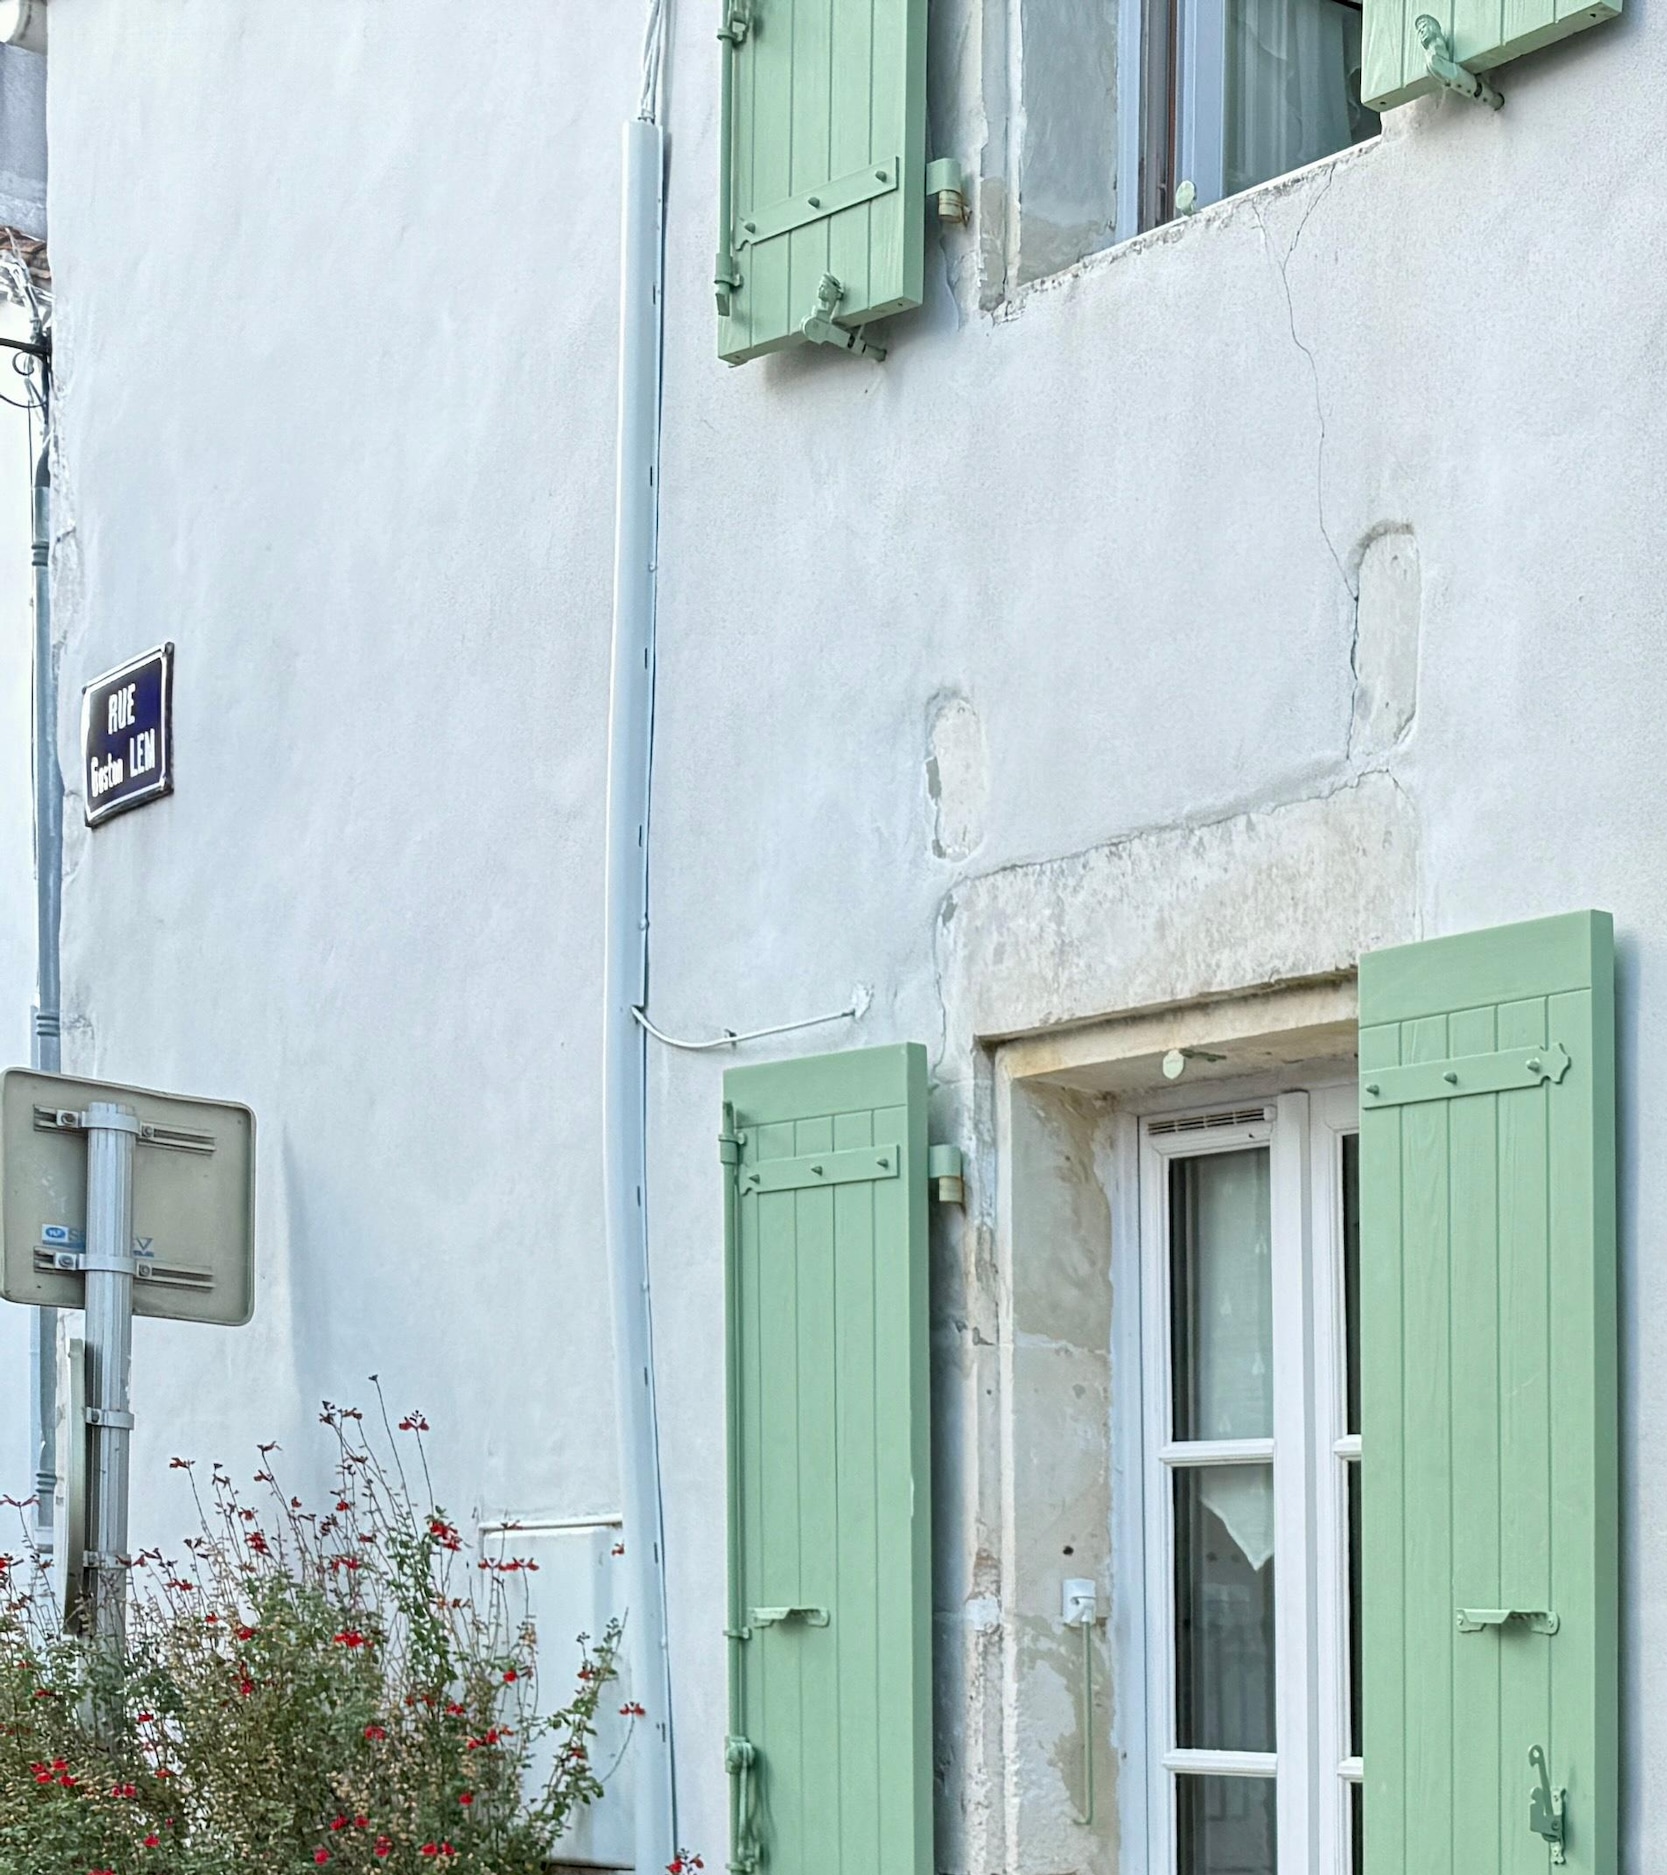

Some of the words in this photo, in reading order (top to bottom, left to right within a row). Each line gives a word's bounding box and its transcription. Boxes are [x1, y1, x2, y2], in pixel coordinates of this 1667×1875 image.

[108, 683, 136, 735] RUE
[91, 753, 124, 798] Gaston
[129, 728, 156, 778] LEM
